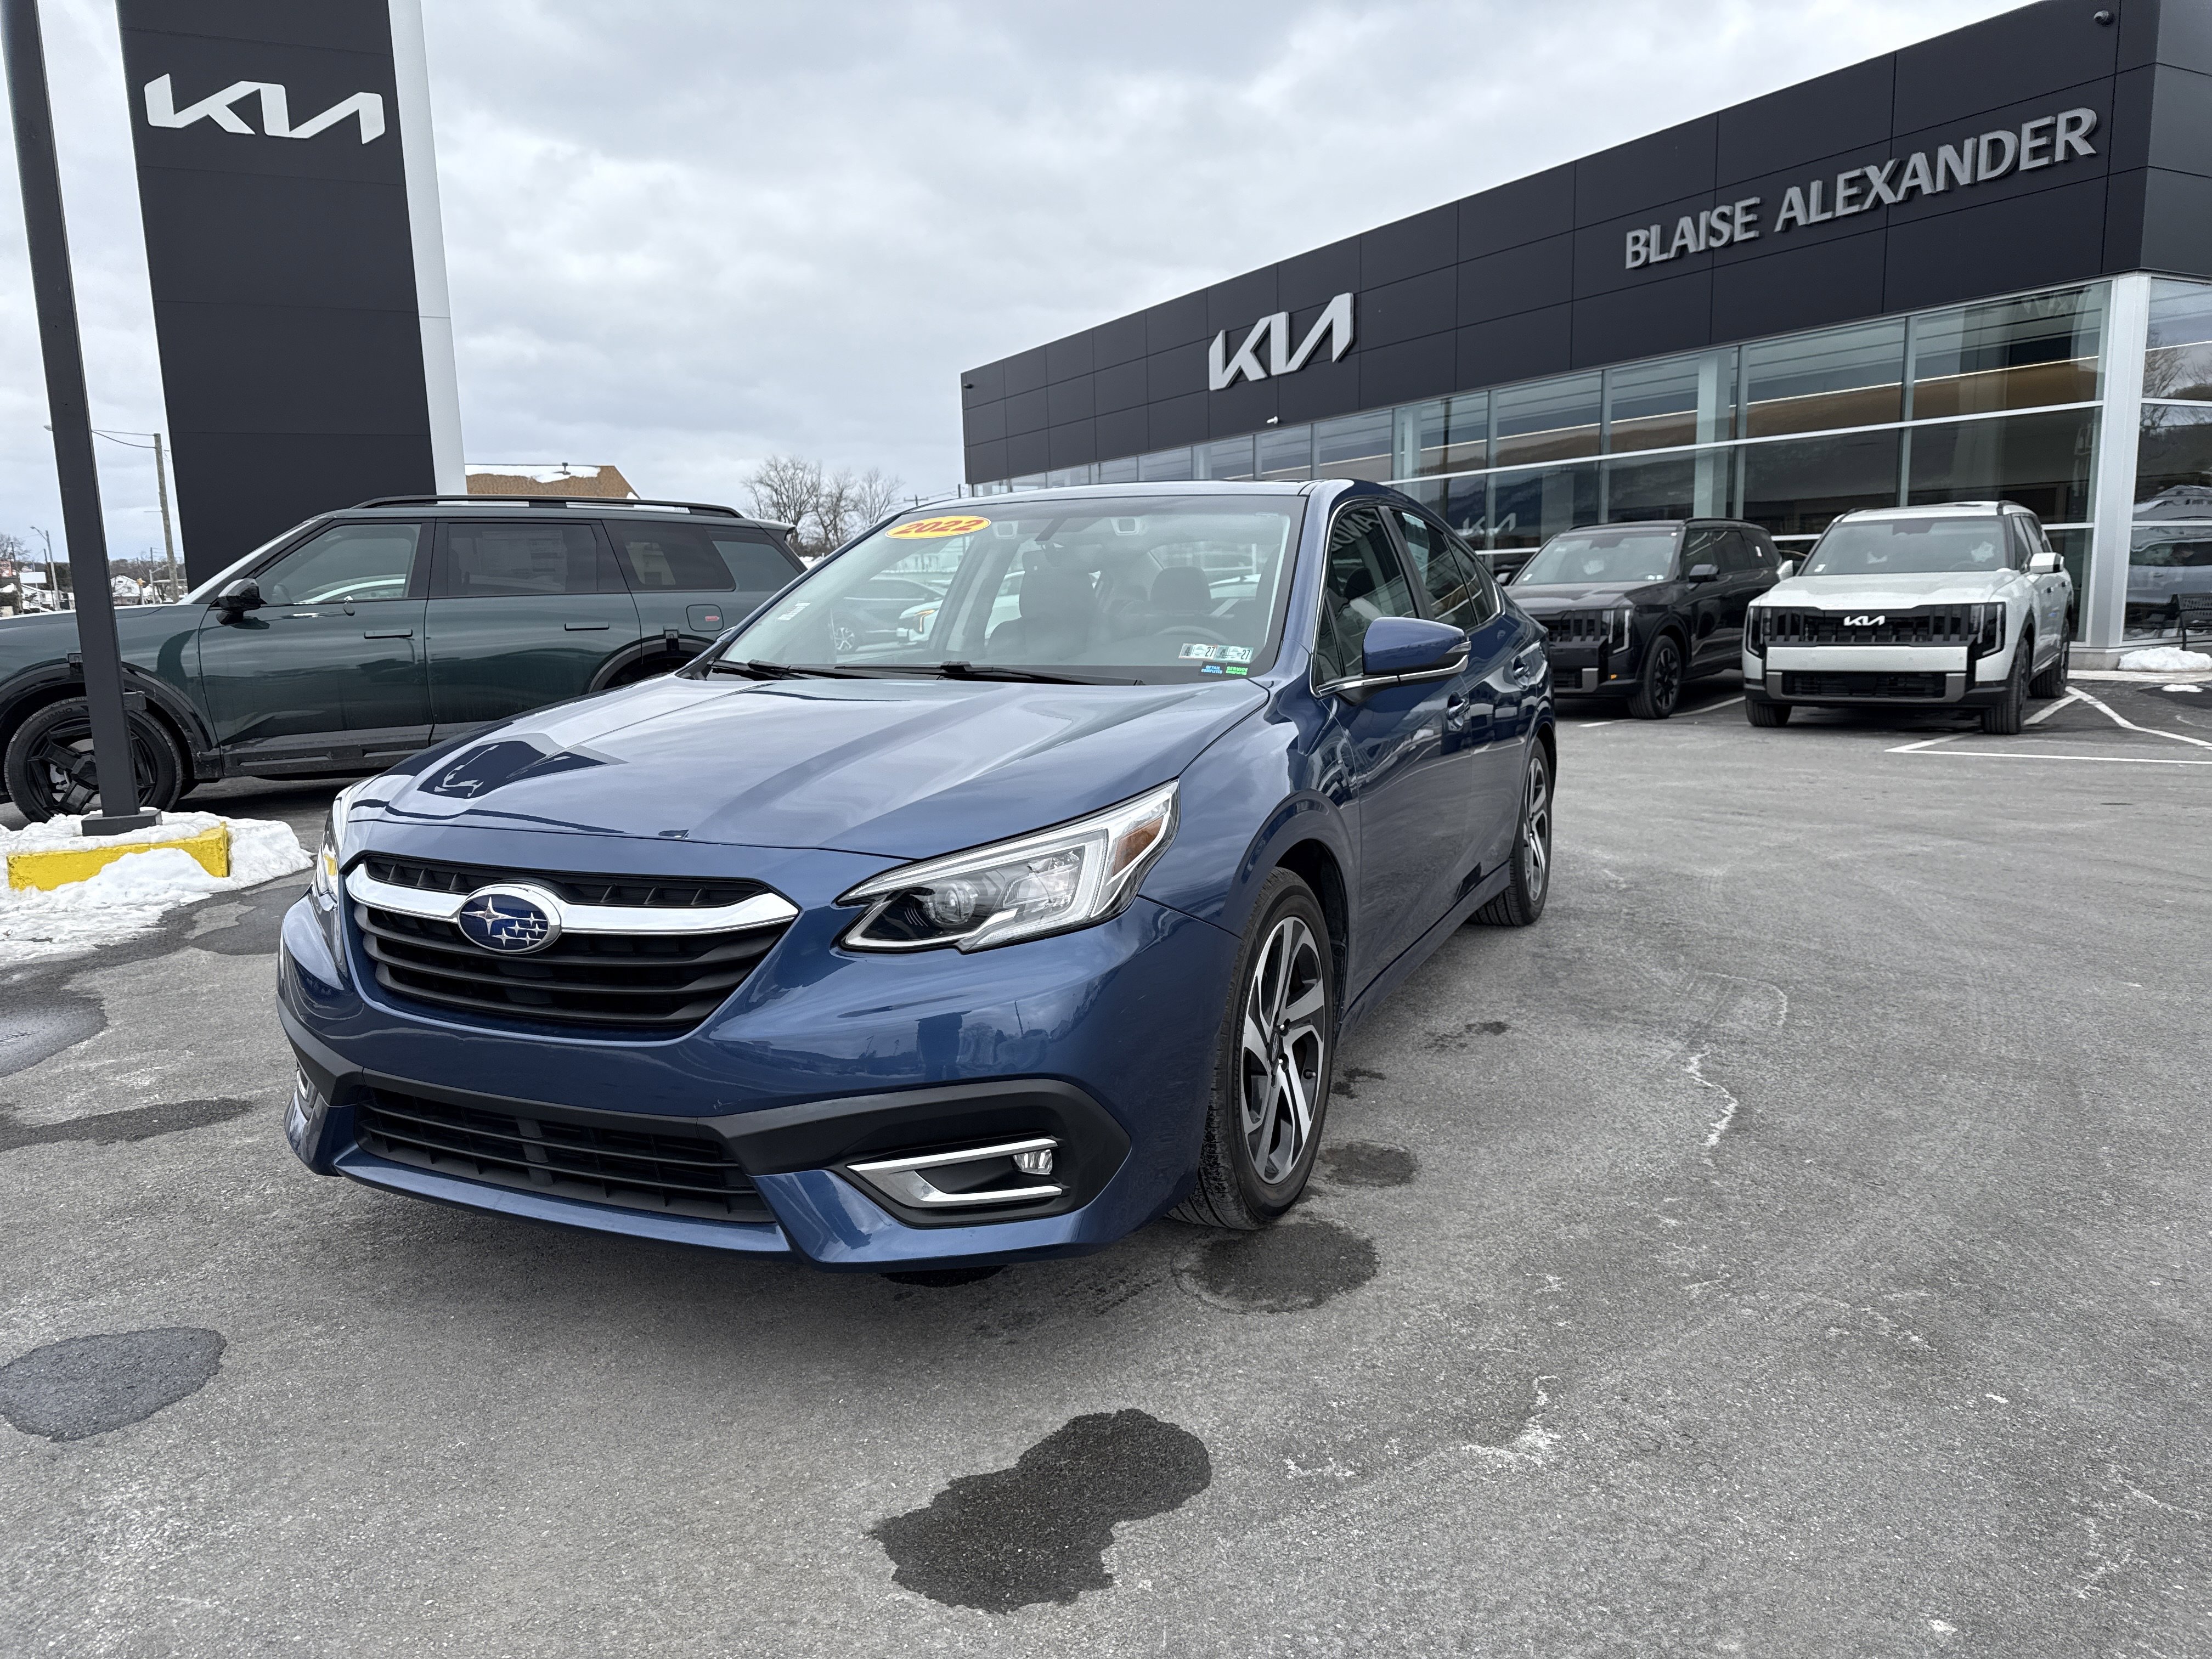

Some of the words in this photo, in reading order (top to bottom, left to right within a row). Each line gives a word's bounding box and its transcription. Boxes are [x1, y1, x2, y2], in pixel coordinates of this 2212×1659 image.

[144, 73, 385, 145] KIA
[1625, 196, 1761, 269] BLAISE
[1774, 107, 2098, 233] ALEXANDER
[1209, 292, 1354, 391] KIA
[893, 520, 984, 534] 2022
[1843, 615, 1886, 626] KIA
[1205, 647, 1216, 657] 27
[1241, 649, 1251, 660] 27
[1236, 990, 1247, 1048] CONTROL
